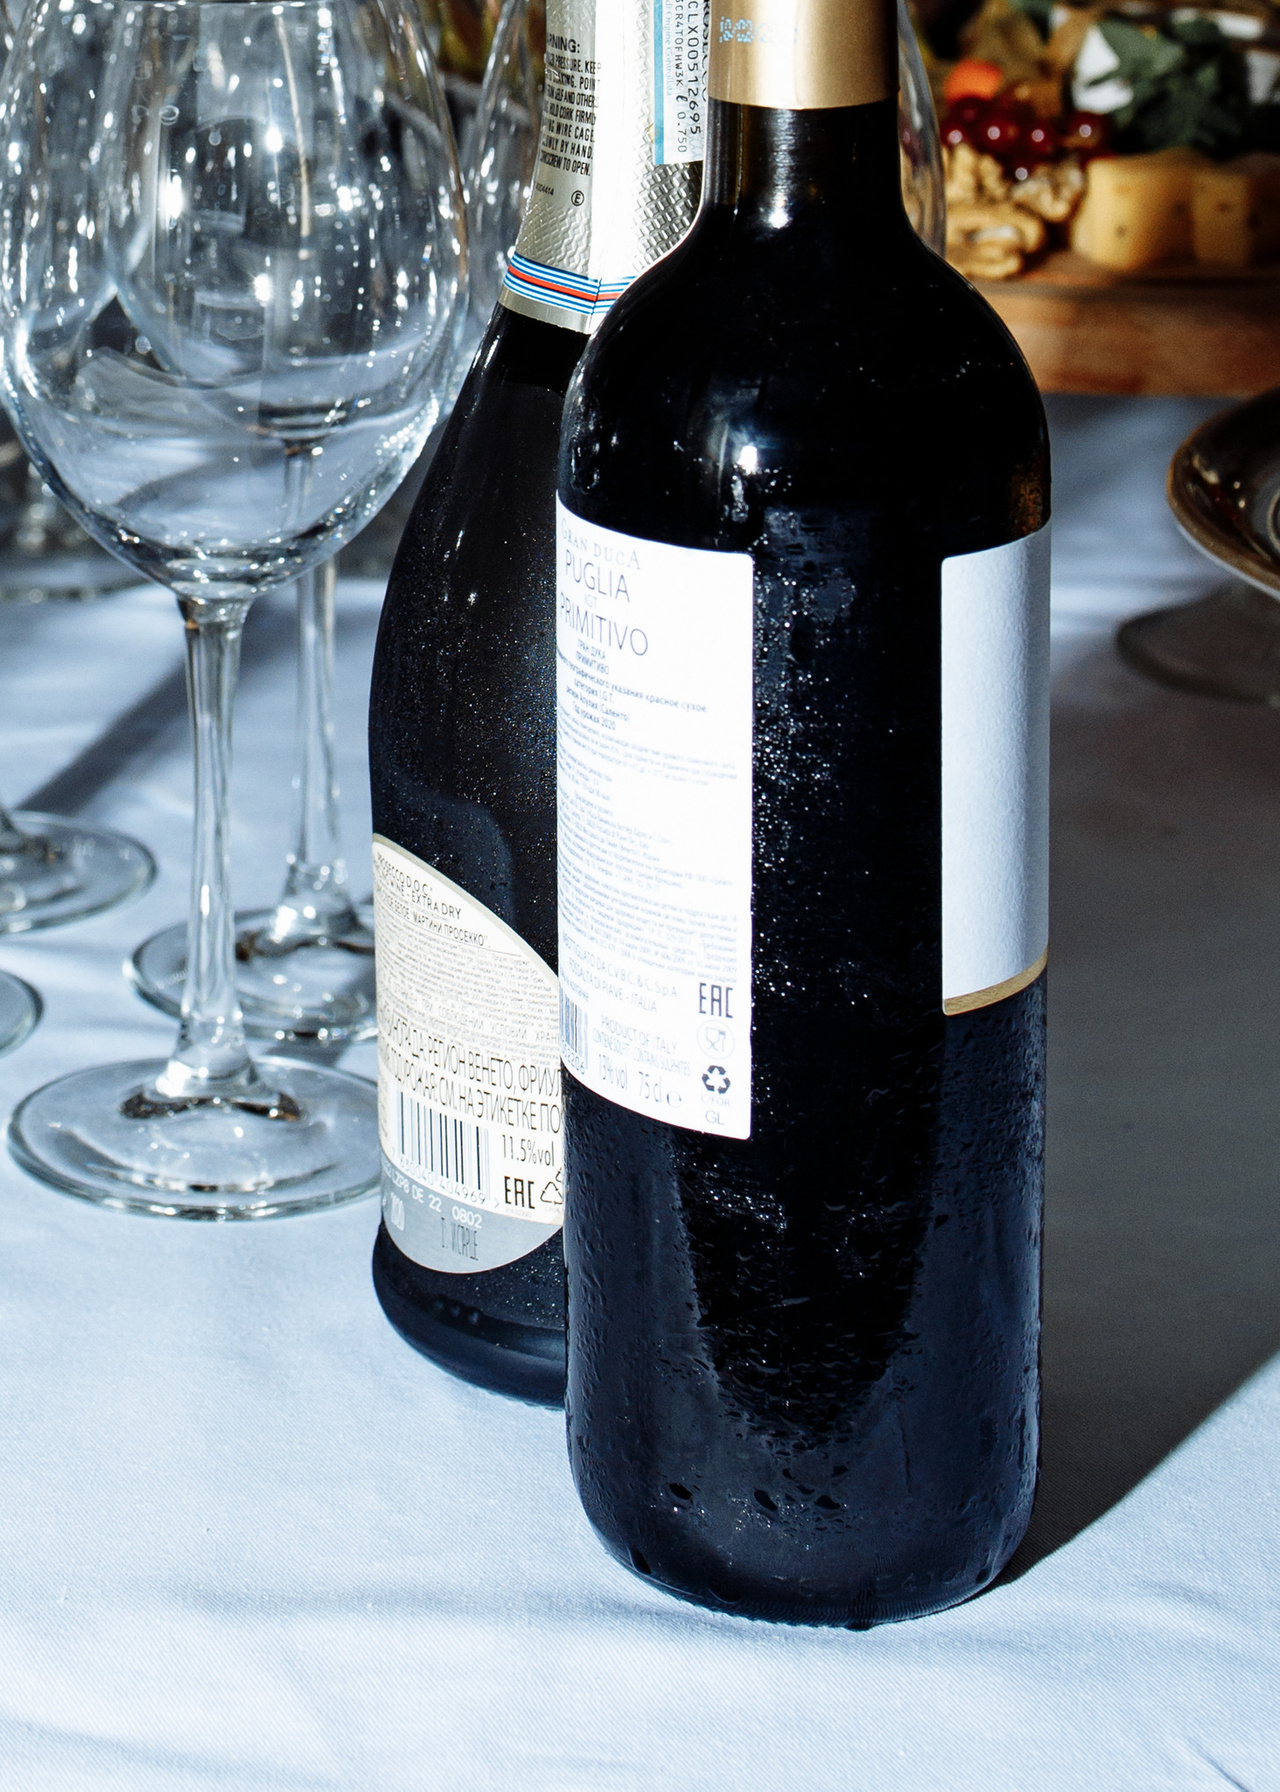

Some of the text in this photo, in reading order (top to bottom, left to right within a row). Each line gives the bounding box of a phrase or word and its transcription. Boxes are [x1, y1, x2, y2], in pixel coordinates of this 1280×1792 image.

[547, 33, 581, 53] RNING:
[677, 111, 688, 153] 0.750
[565, 551, 631, 601] PUGLIA
[560, 594, 649, 655] PRIMITIVO
[645, 694, 679, 709] красное
[681, 702, 707, 715] сухое
[411, 891, 439, 912] EXTRA
[441, 903, 462, 920] DRY
[631, 993, 658, 1014] ITALIA
[600, 1014, 637, 1042] PRODUCT
[652, 1036, 678, 1055] ITALY
[428, 1038, 466, 1075] РЕГИОН
[468, 1054, 517, 1091] ВЕНЕТО,
[476, 1092, 537, 1129] ЭТИКЕТКЕ
[705, 1110, 725, 1126] GL
[428, 1193, 443, 1213] 22
[451, 1206, 483, 1229] 0802
